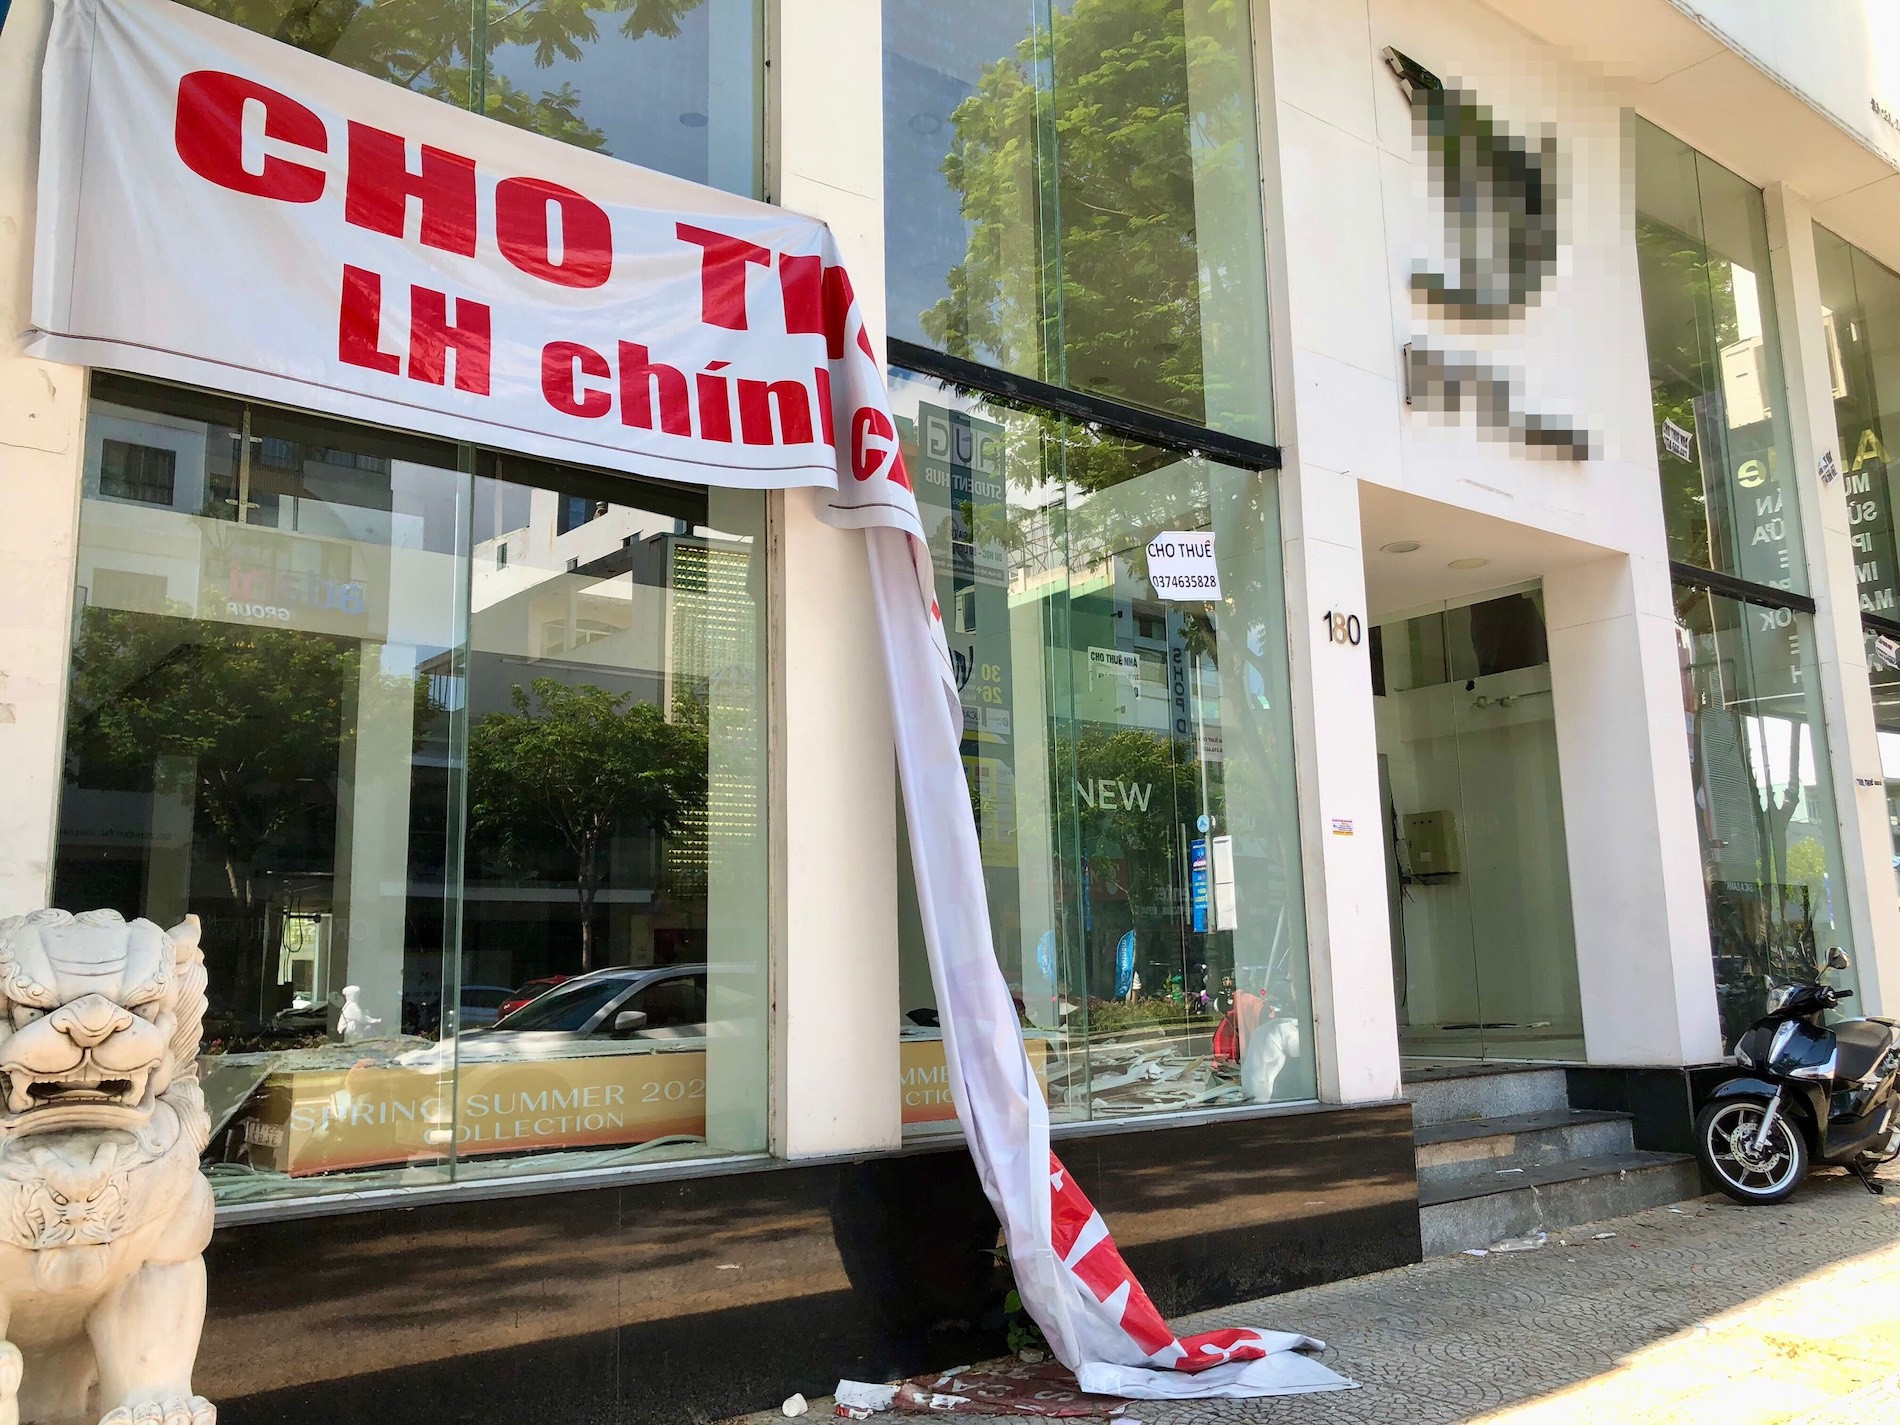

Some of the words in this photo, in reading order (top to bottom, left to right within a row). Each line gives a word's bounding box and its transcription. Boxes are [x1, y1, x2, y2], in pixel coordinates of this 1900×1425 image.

[174, 70, 613, 289] CHO
[338, 263, 491, 397] LH
[1147, 543, 1175, 558] CHO
[1178, 540, 1212, 558] THUÊ
[1152, 574, 1217, 588] 0374635828
[1322, 610, 1361, 646] 180
[1090, 651, 1105, 664] CHO
[1106, 652, 1123, 666] THUÊ
[1123, 654, 1138, 668] NHÀ
[1071, 778, 1153, 812] NEW
[465, 1083, 625, 1118] SUMMER
[423, 1111, 625, 1146] COLLECTION
